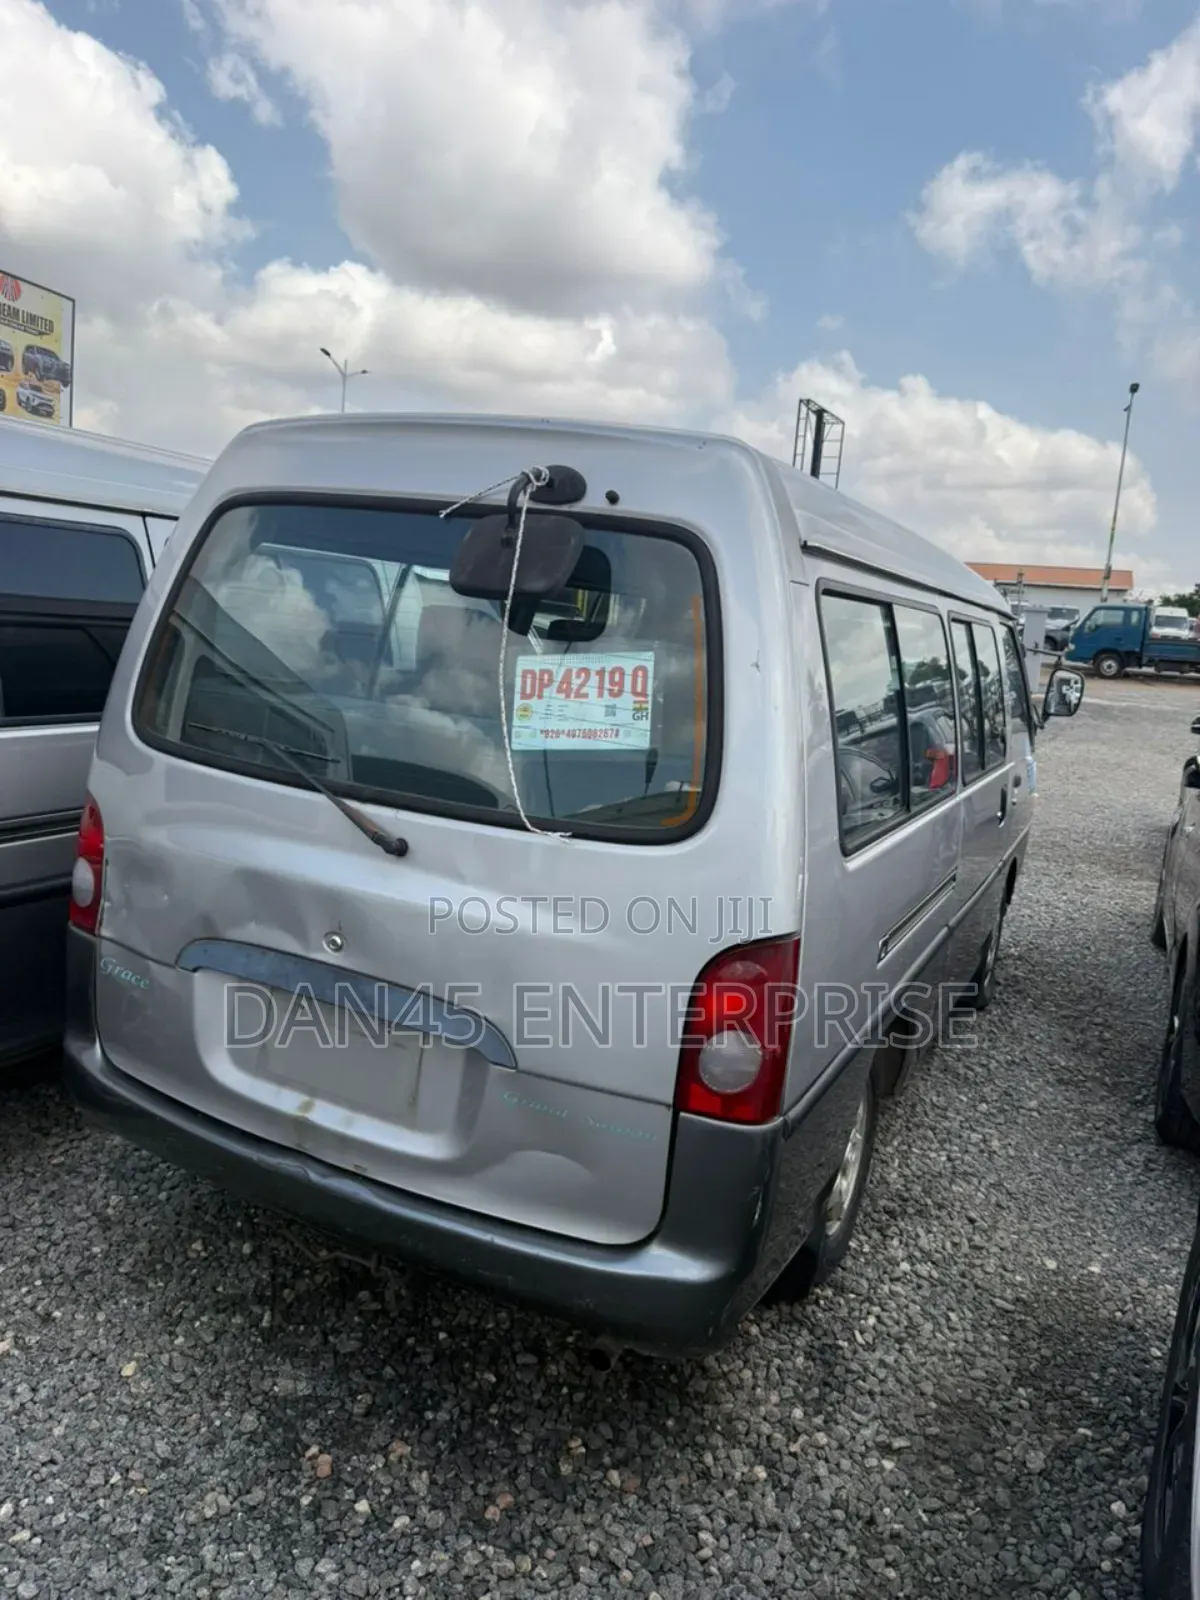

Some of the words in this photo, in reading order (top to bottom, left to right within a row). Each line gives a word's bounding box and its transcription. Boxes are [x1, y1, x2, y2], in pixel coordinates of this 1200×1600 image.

[0, 301, 20, 321] EAM
[21, 309, 55, 333] LIMITED
[632, 712, 649, 721] GH
[100, 956, 150, 990] Grace
[501, 1090, 568, 1119] Grand
